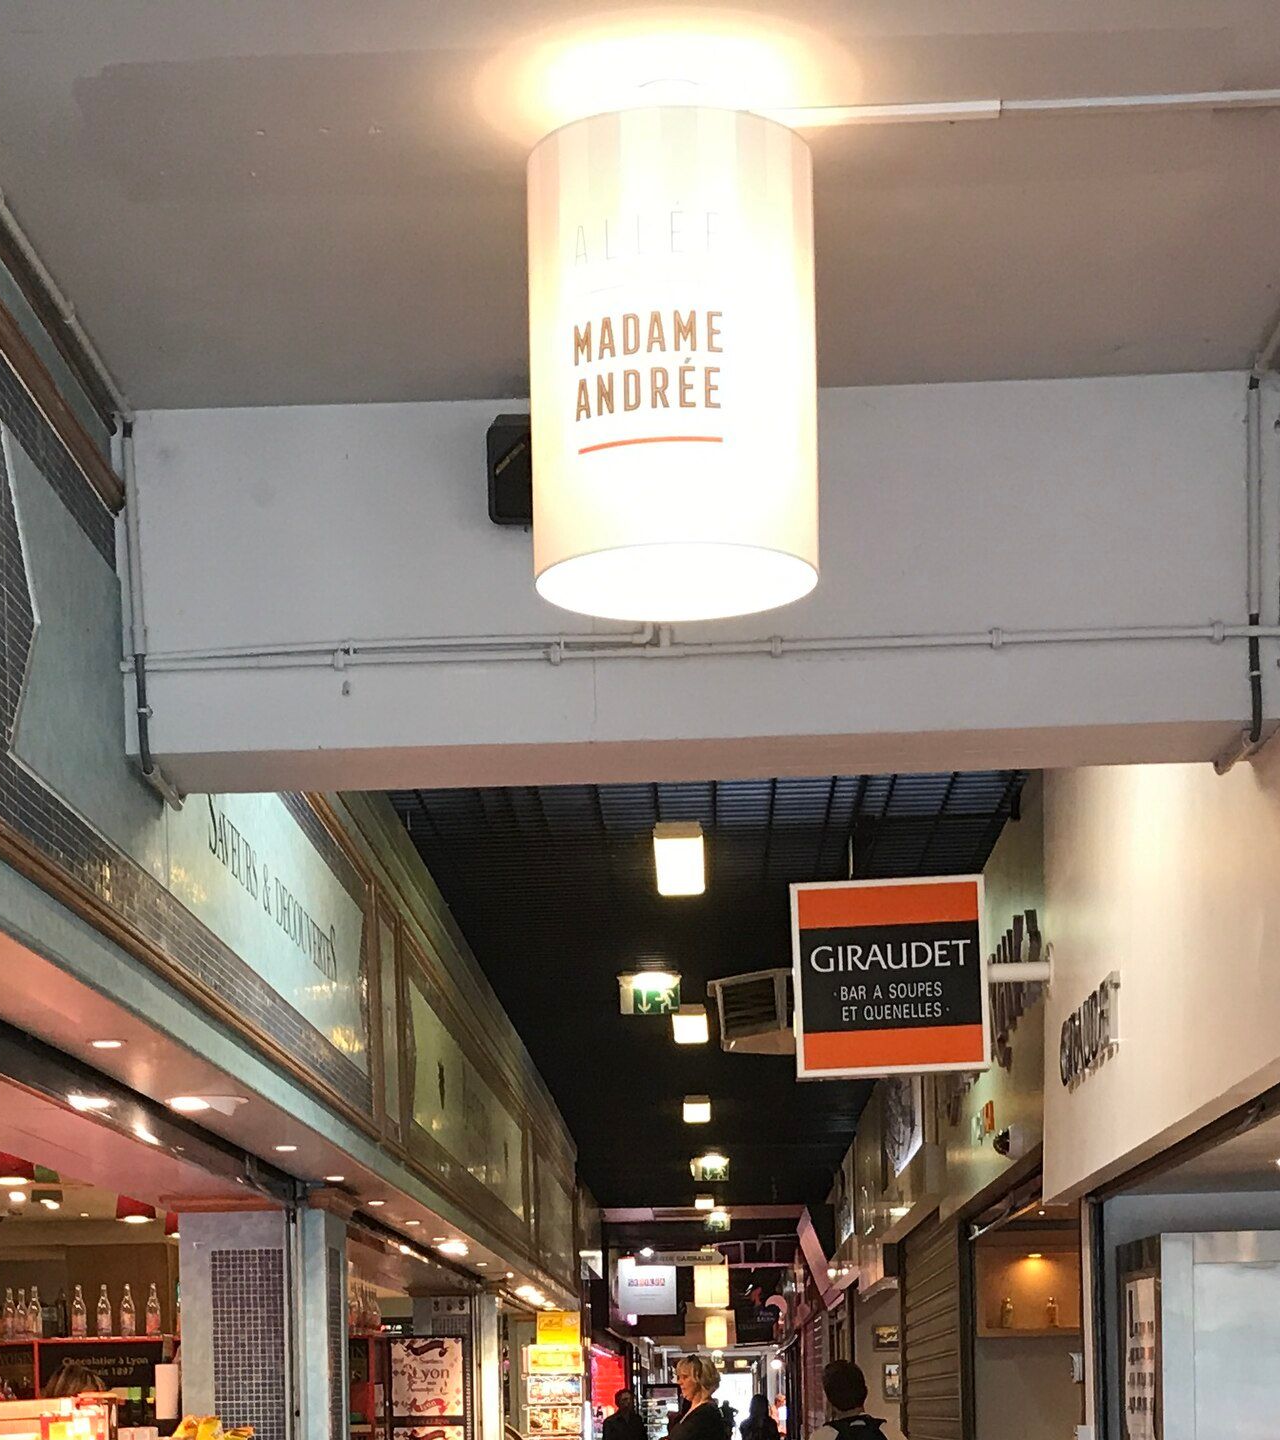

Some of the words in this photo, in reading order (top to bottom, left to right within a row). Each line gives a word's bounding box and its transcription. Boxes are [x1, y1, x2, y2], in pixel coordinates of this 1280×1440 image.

[573, 310, 723, 366] MADAME
[575, 357, 721, 422] ANDRÉE
[207, 793, 258, 901] SAVEURS
[263, 863, 272, 916] &
[275, 877, 337, 981] DECOUVERTES
[810, 939, 971, 973] GIRAUDET
[840, 985, 867, 1001] BAR
[873, 985, 883, 999] A
[889, 981, 943, 999] SOUPES
[842, 1006, 858, 1022] ET
[863, 1002, 942, 1021] QUENELLES
[126, 1357, 149, 1366] Lyon
